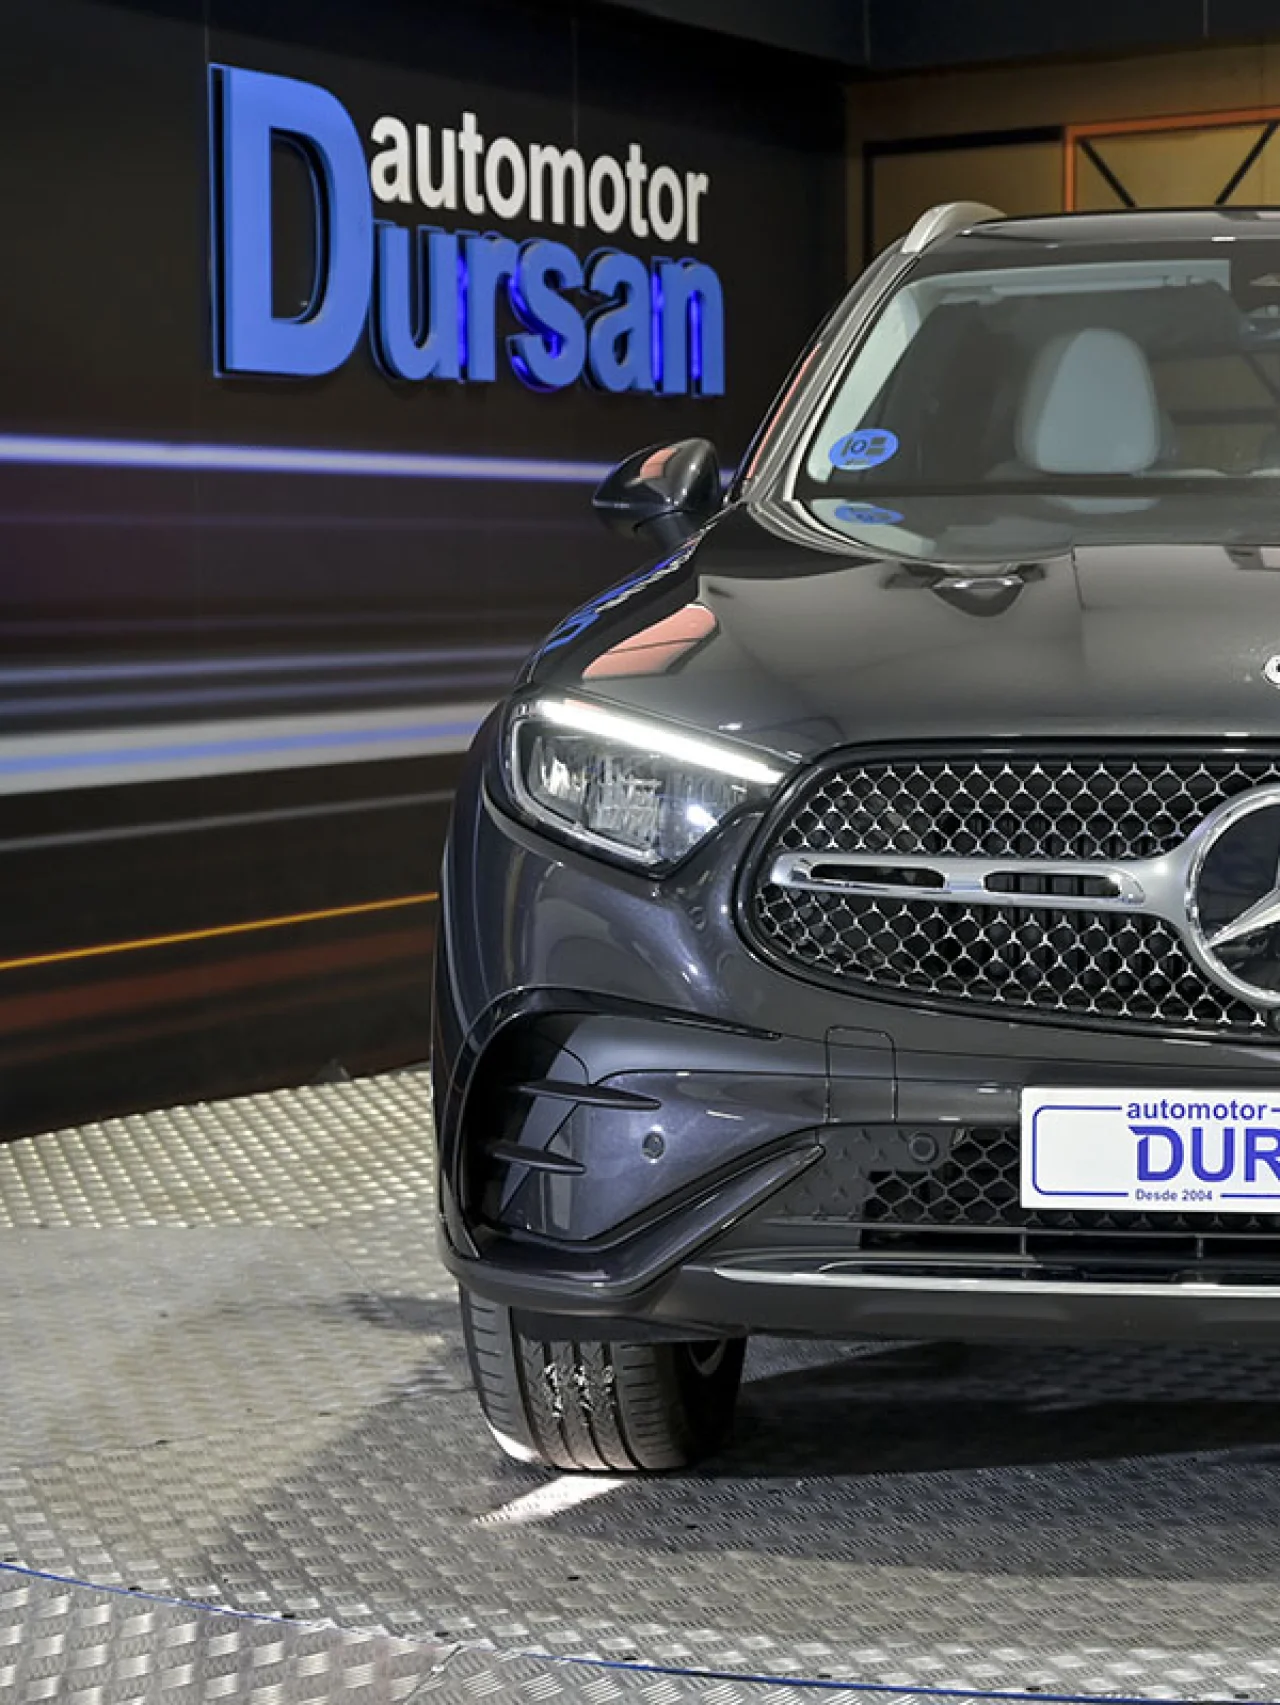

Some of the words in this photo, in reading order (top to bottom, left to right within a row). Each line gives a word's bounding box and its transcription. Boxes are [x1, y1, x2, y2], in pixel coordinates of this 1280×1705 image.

[369, 111, 709, 244] automotor
[208, 62, 726, 398] Dursan
[1126, 1099, 1268, 1121] automotor
[1135, 1189, 1178, 1201] Desde
[1182, 1189, 1213, 1201] 2004
